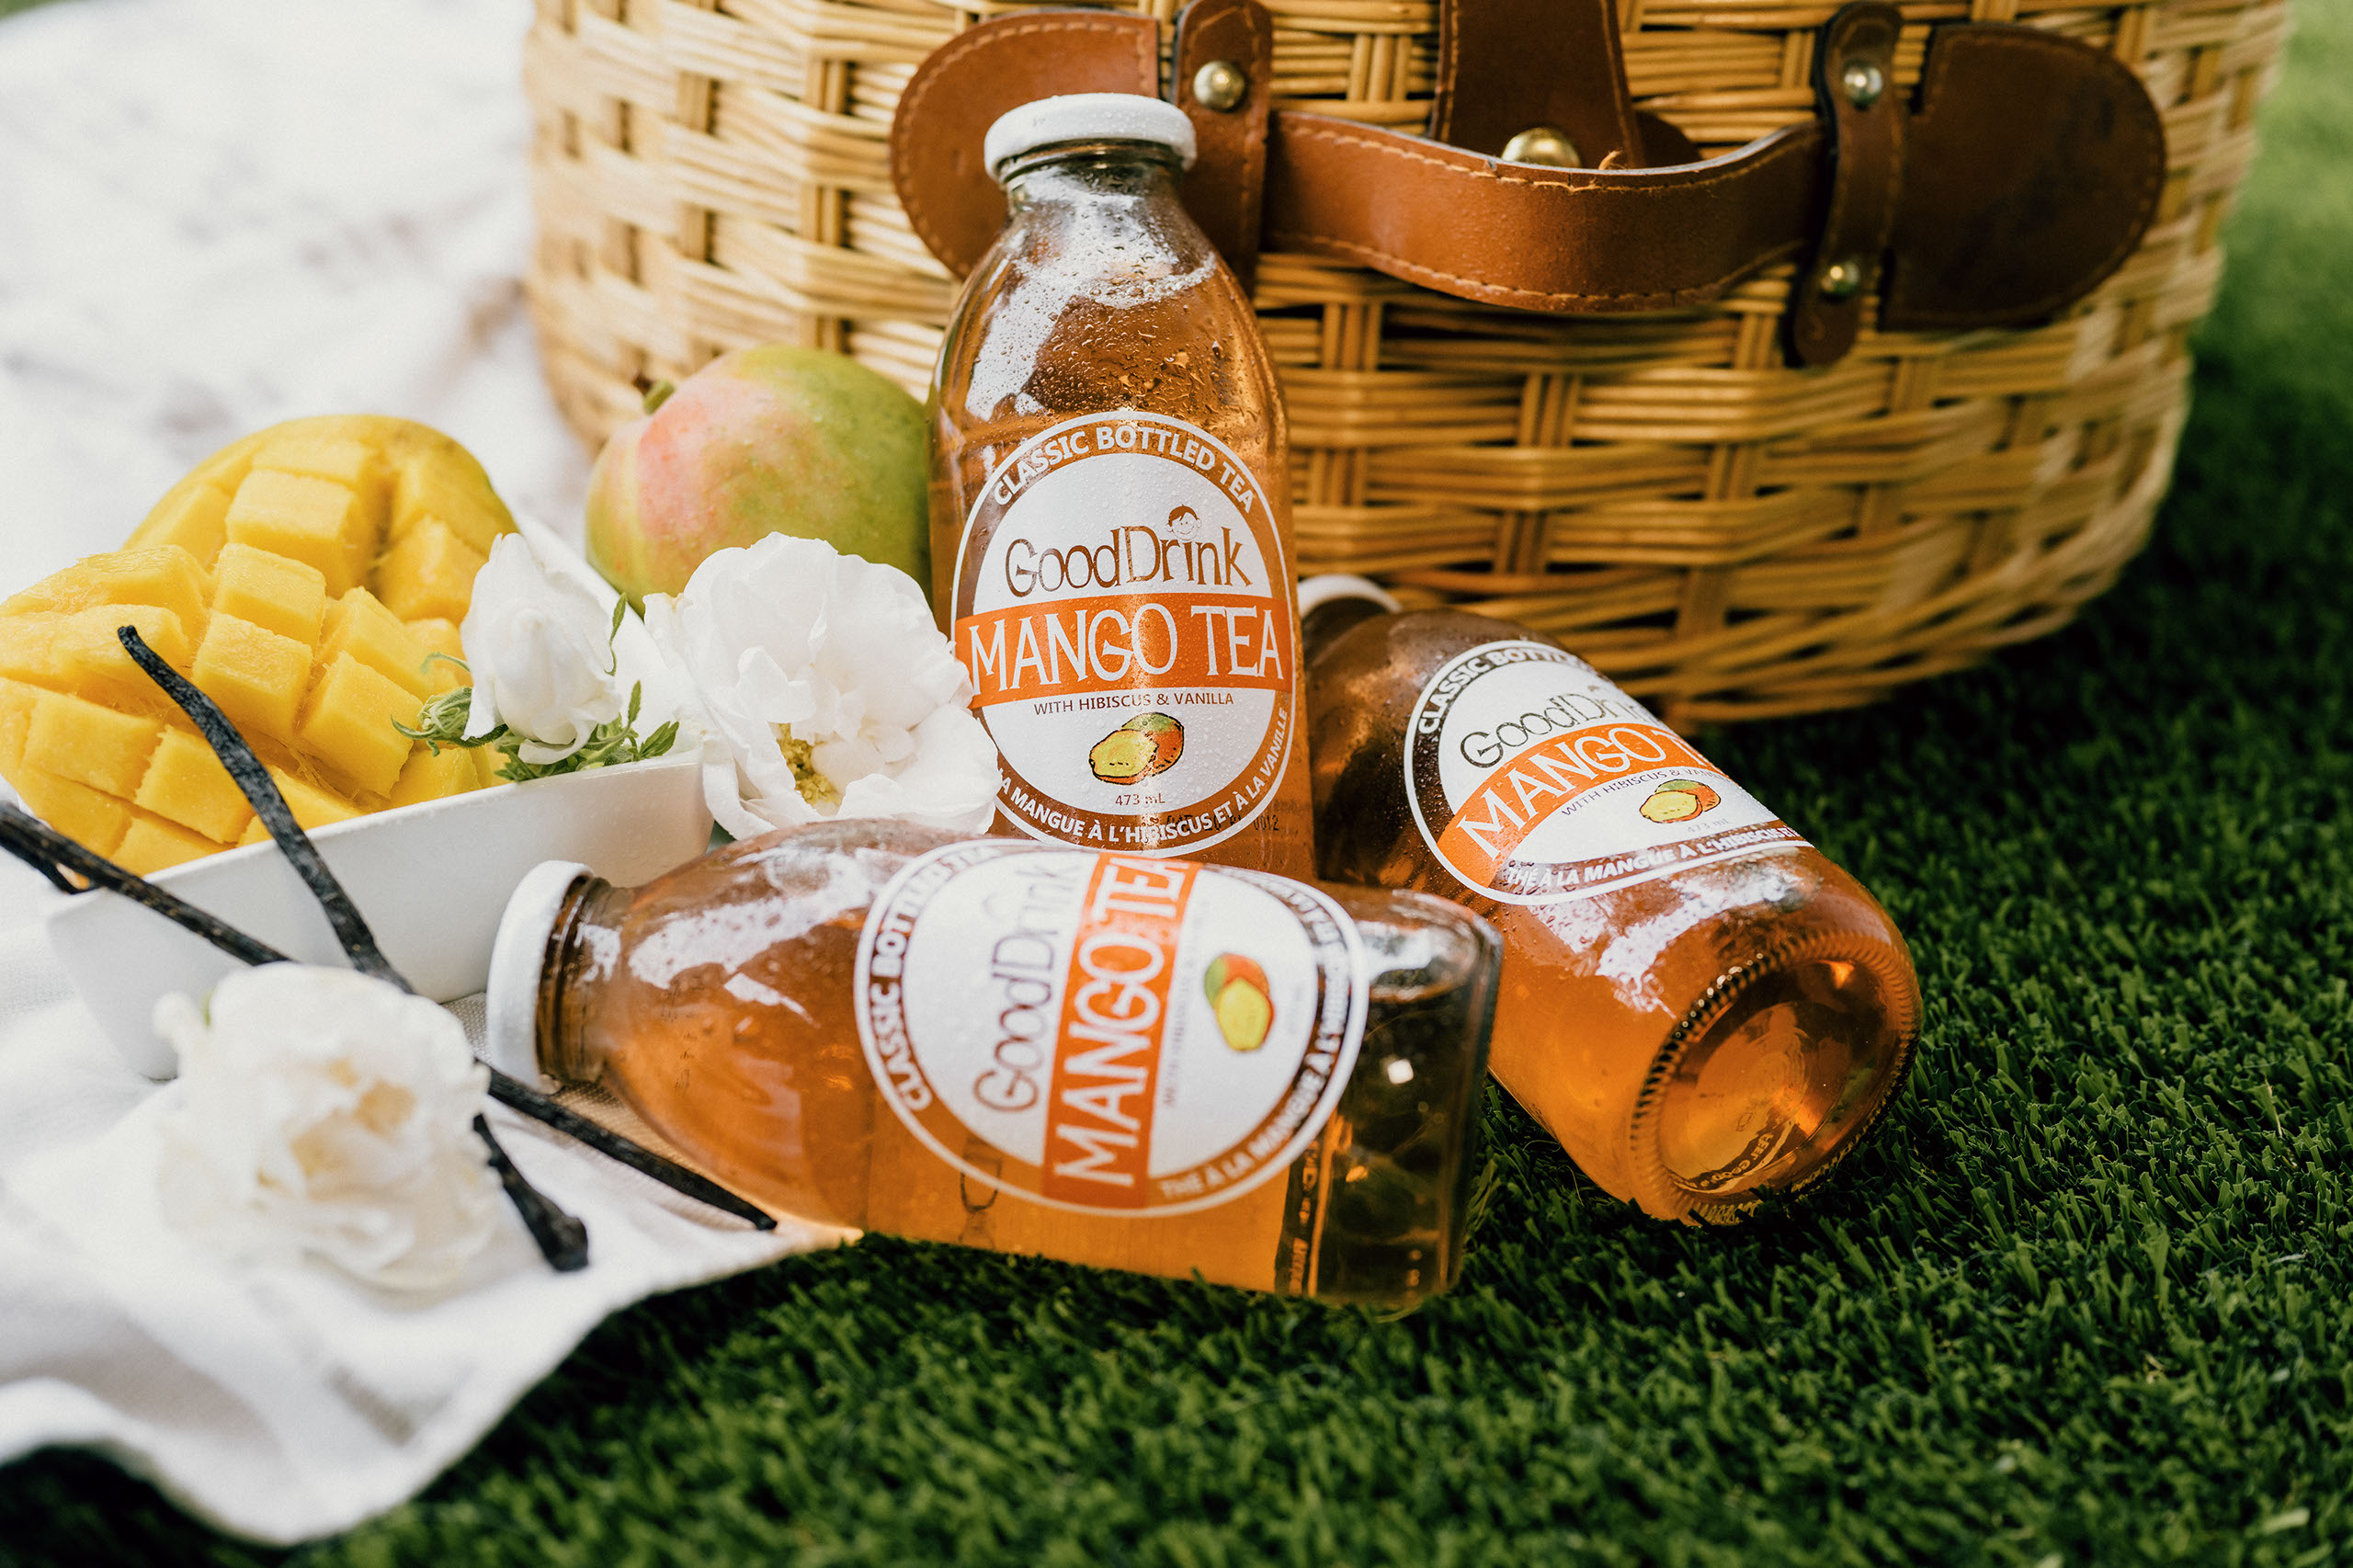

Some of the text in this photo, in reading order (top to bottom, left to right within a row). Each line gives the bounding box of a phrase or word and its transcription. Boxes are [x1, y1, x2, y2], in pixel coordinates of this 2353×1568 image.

[994, 425, 1258, 515] CLASSIC BOTTLED TEA
[1005, 524, 1254, 597] GoodDrink
[969, 603, 1285, 697] MANGO TEA
[1034, 692, 1235, 716] WITH HIBISCUS & VANILLA
[1418, 656, 1491, 735] CLASSIC
[1009, 789, 1086, 840] MANGUE
[1088, 819, 1103, 841] À
[1108, 815, 1213, 845] L'HIBISCUS
[1212, 801, 1235, 823] ET
[1235, 790, 1250, 812] À
[1247, 777, 1266, 801] LA
[1259, 706, 1290, 778] VANILLE
[1115, 793, 1166, 806] 473 mL
[1456, 726, 1666, 862] MANGO
[1562, 790, 1603, 817] WITH
[1603, 769, 1668, 801] HIBISCUS
[1669, 768, 1682, 779] &
[1506, 864, 1539, 888] THÉ
[1556, 869, 1580, 888] LA
[1583, 848, 1677, 883] MANGUE
[871, 981, 933, 1112] CLASSIC
[1053, 852, 1190, 1189] MANGO TEA
